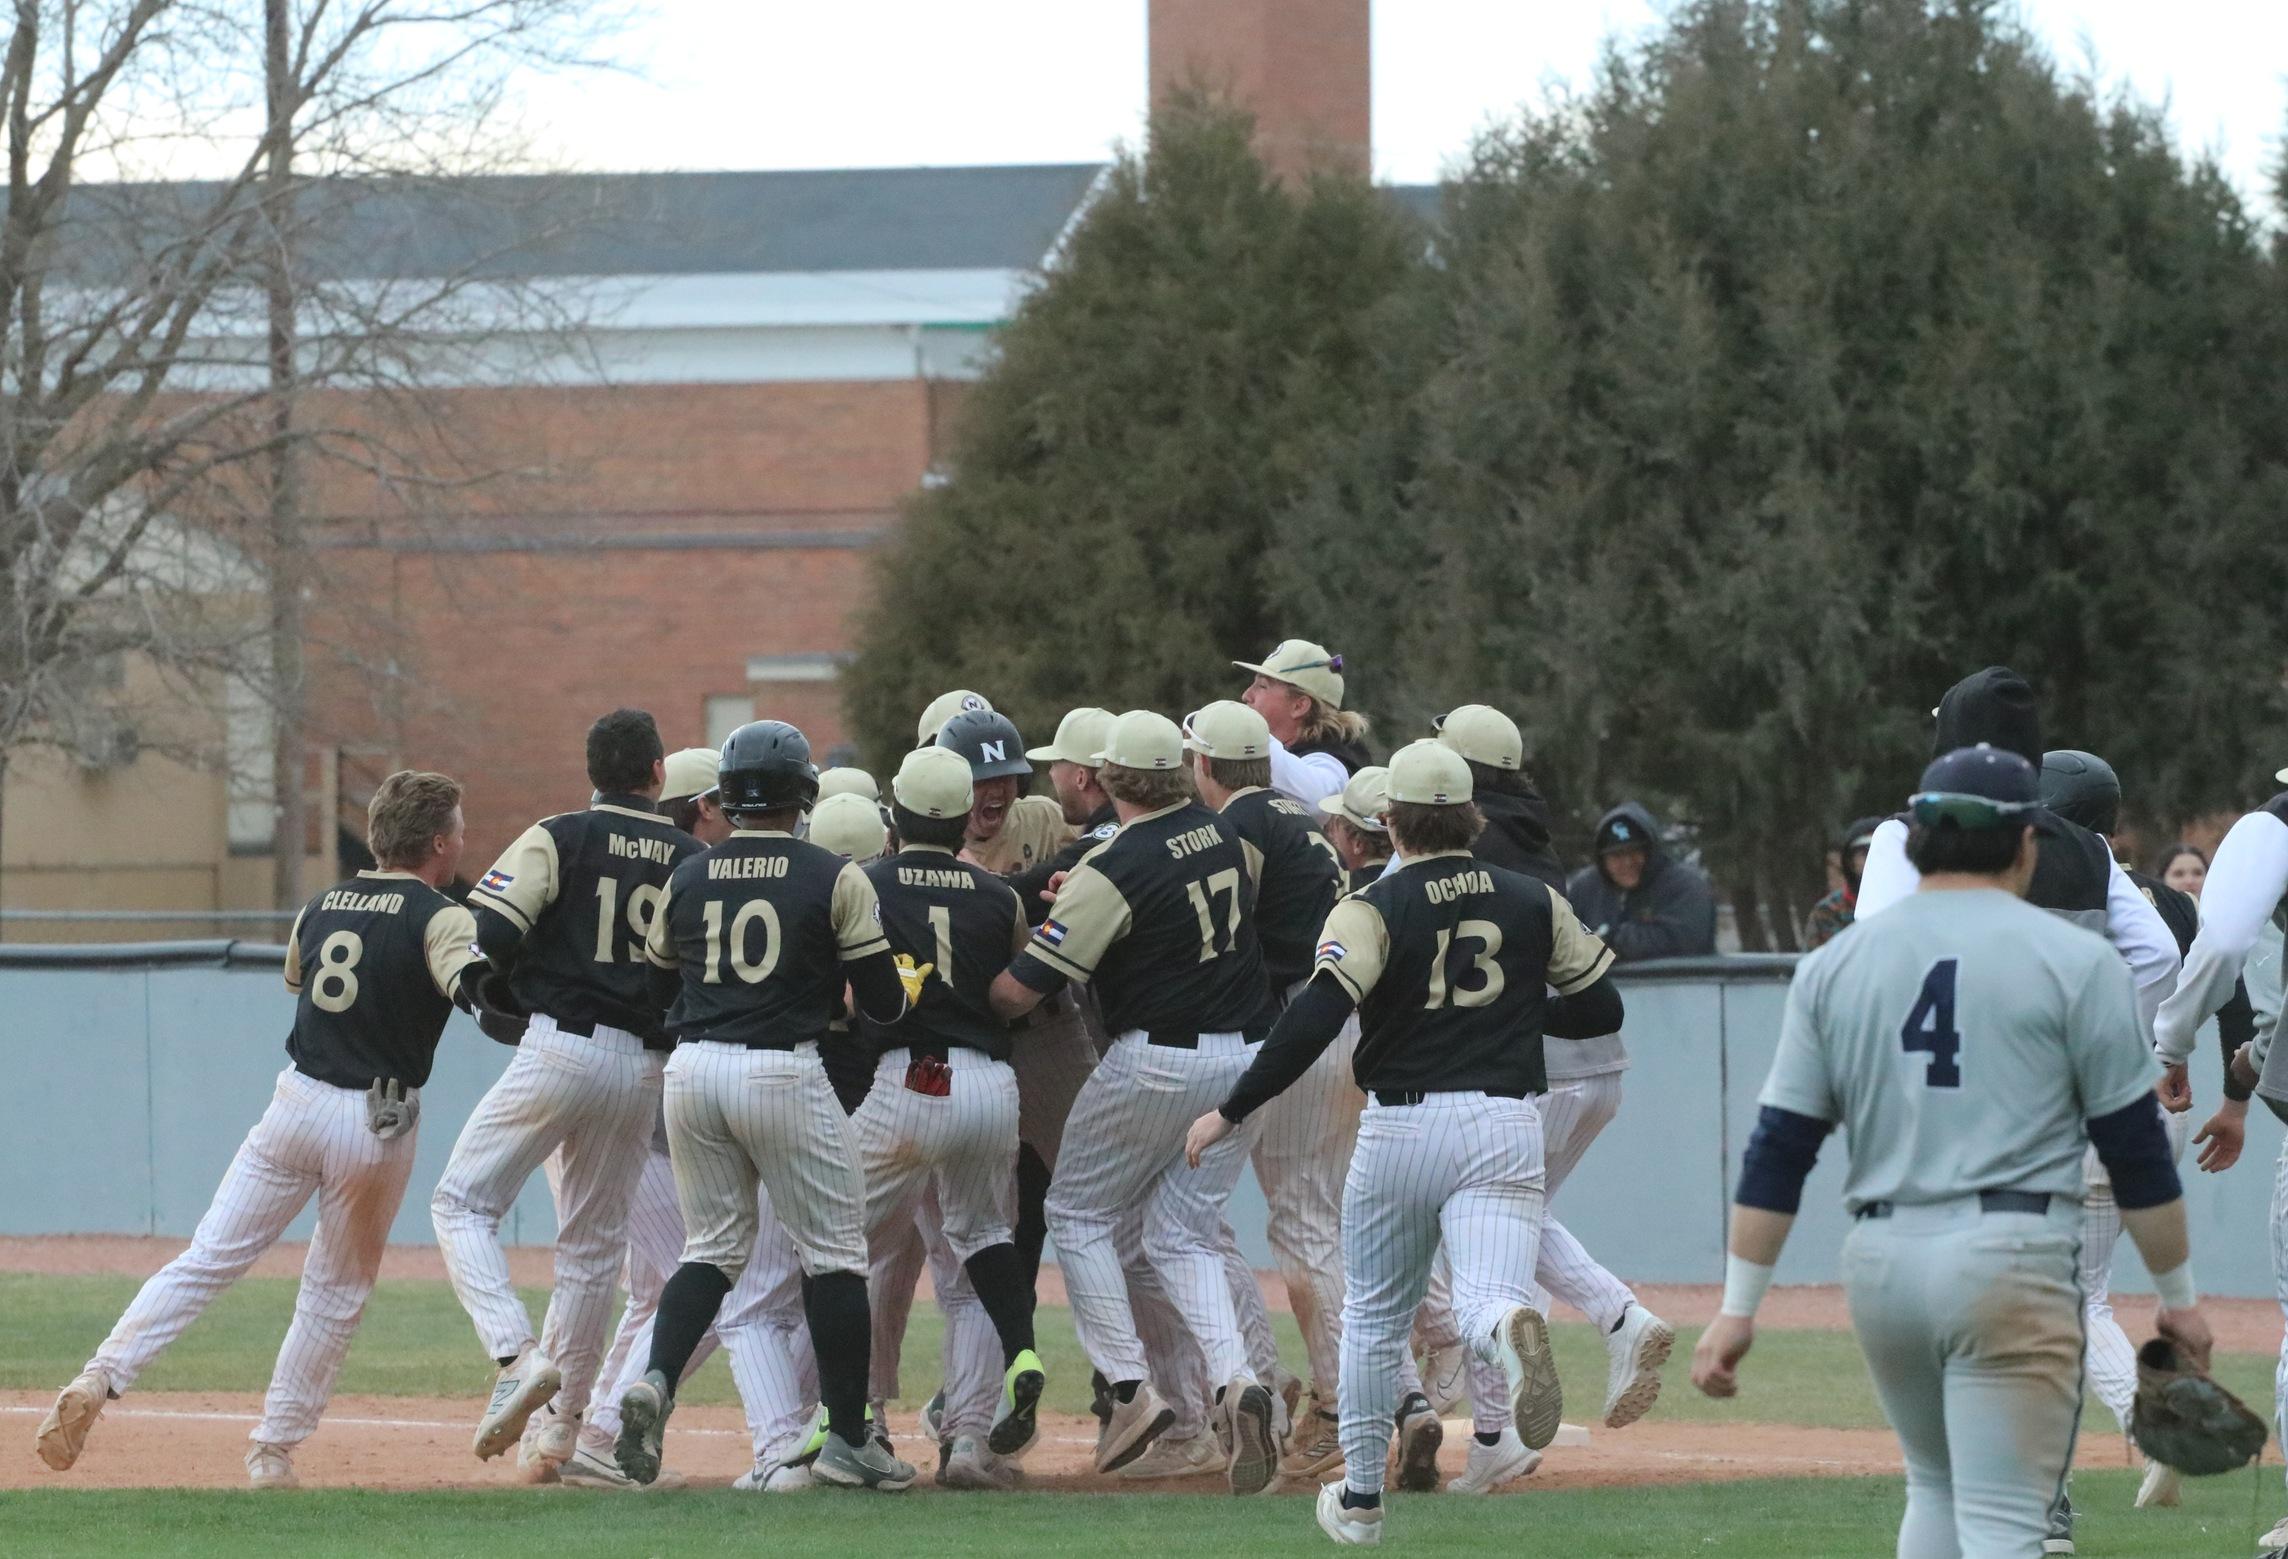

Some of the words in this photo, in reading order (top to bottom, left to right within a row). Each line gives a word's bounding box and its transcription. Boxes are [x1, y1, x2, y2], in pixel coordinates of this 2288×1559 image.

[980, 740, 1007, 763] N
[608, 832, 676, 865] McVAY
[708, 856, 789, 880] VALERIO
[1165, 823, 1224, 859] STORK
[321, 890, 405, 915] CLELLAND
[897, 867, 976, 890] UZAWA
[1424, 870, 1496, 905] OCHOA
[593, 876, 662, 963] 19
[702, 898, 782, 984] 10
[1185, 867, 1241, 963] 17
[311, 930, 363, 1013] 8
[928, 905, 954, 988] 1
[1423, 919, 1505, 1010] 13
[1899, 957, 1962, 1089] 4
